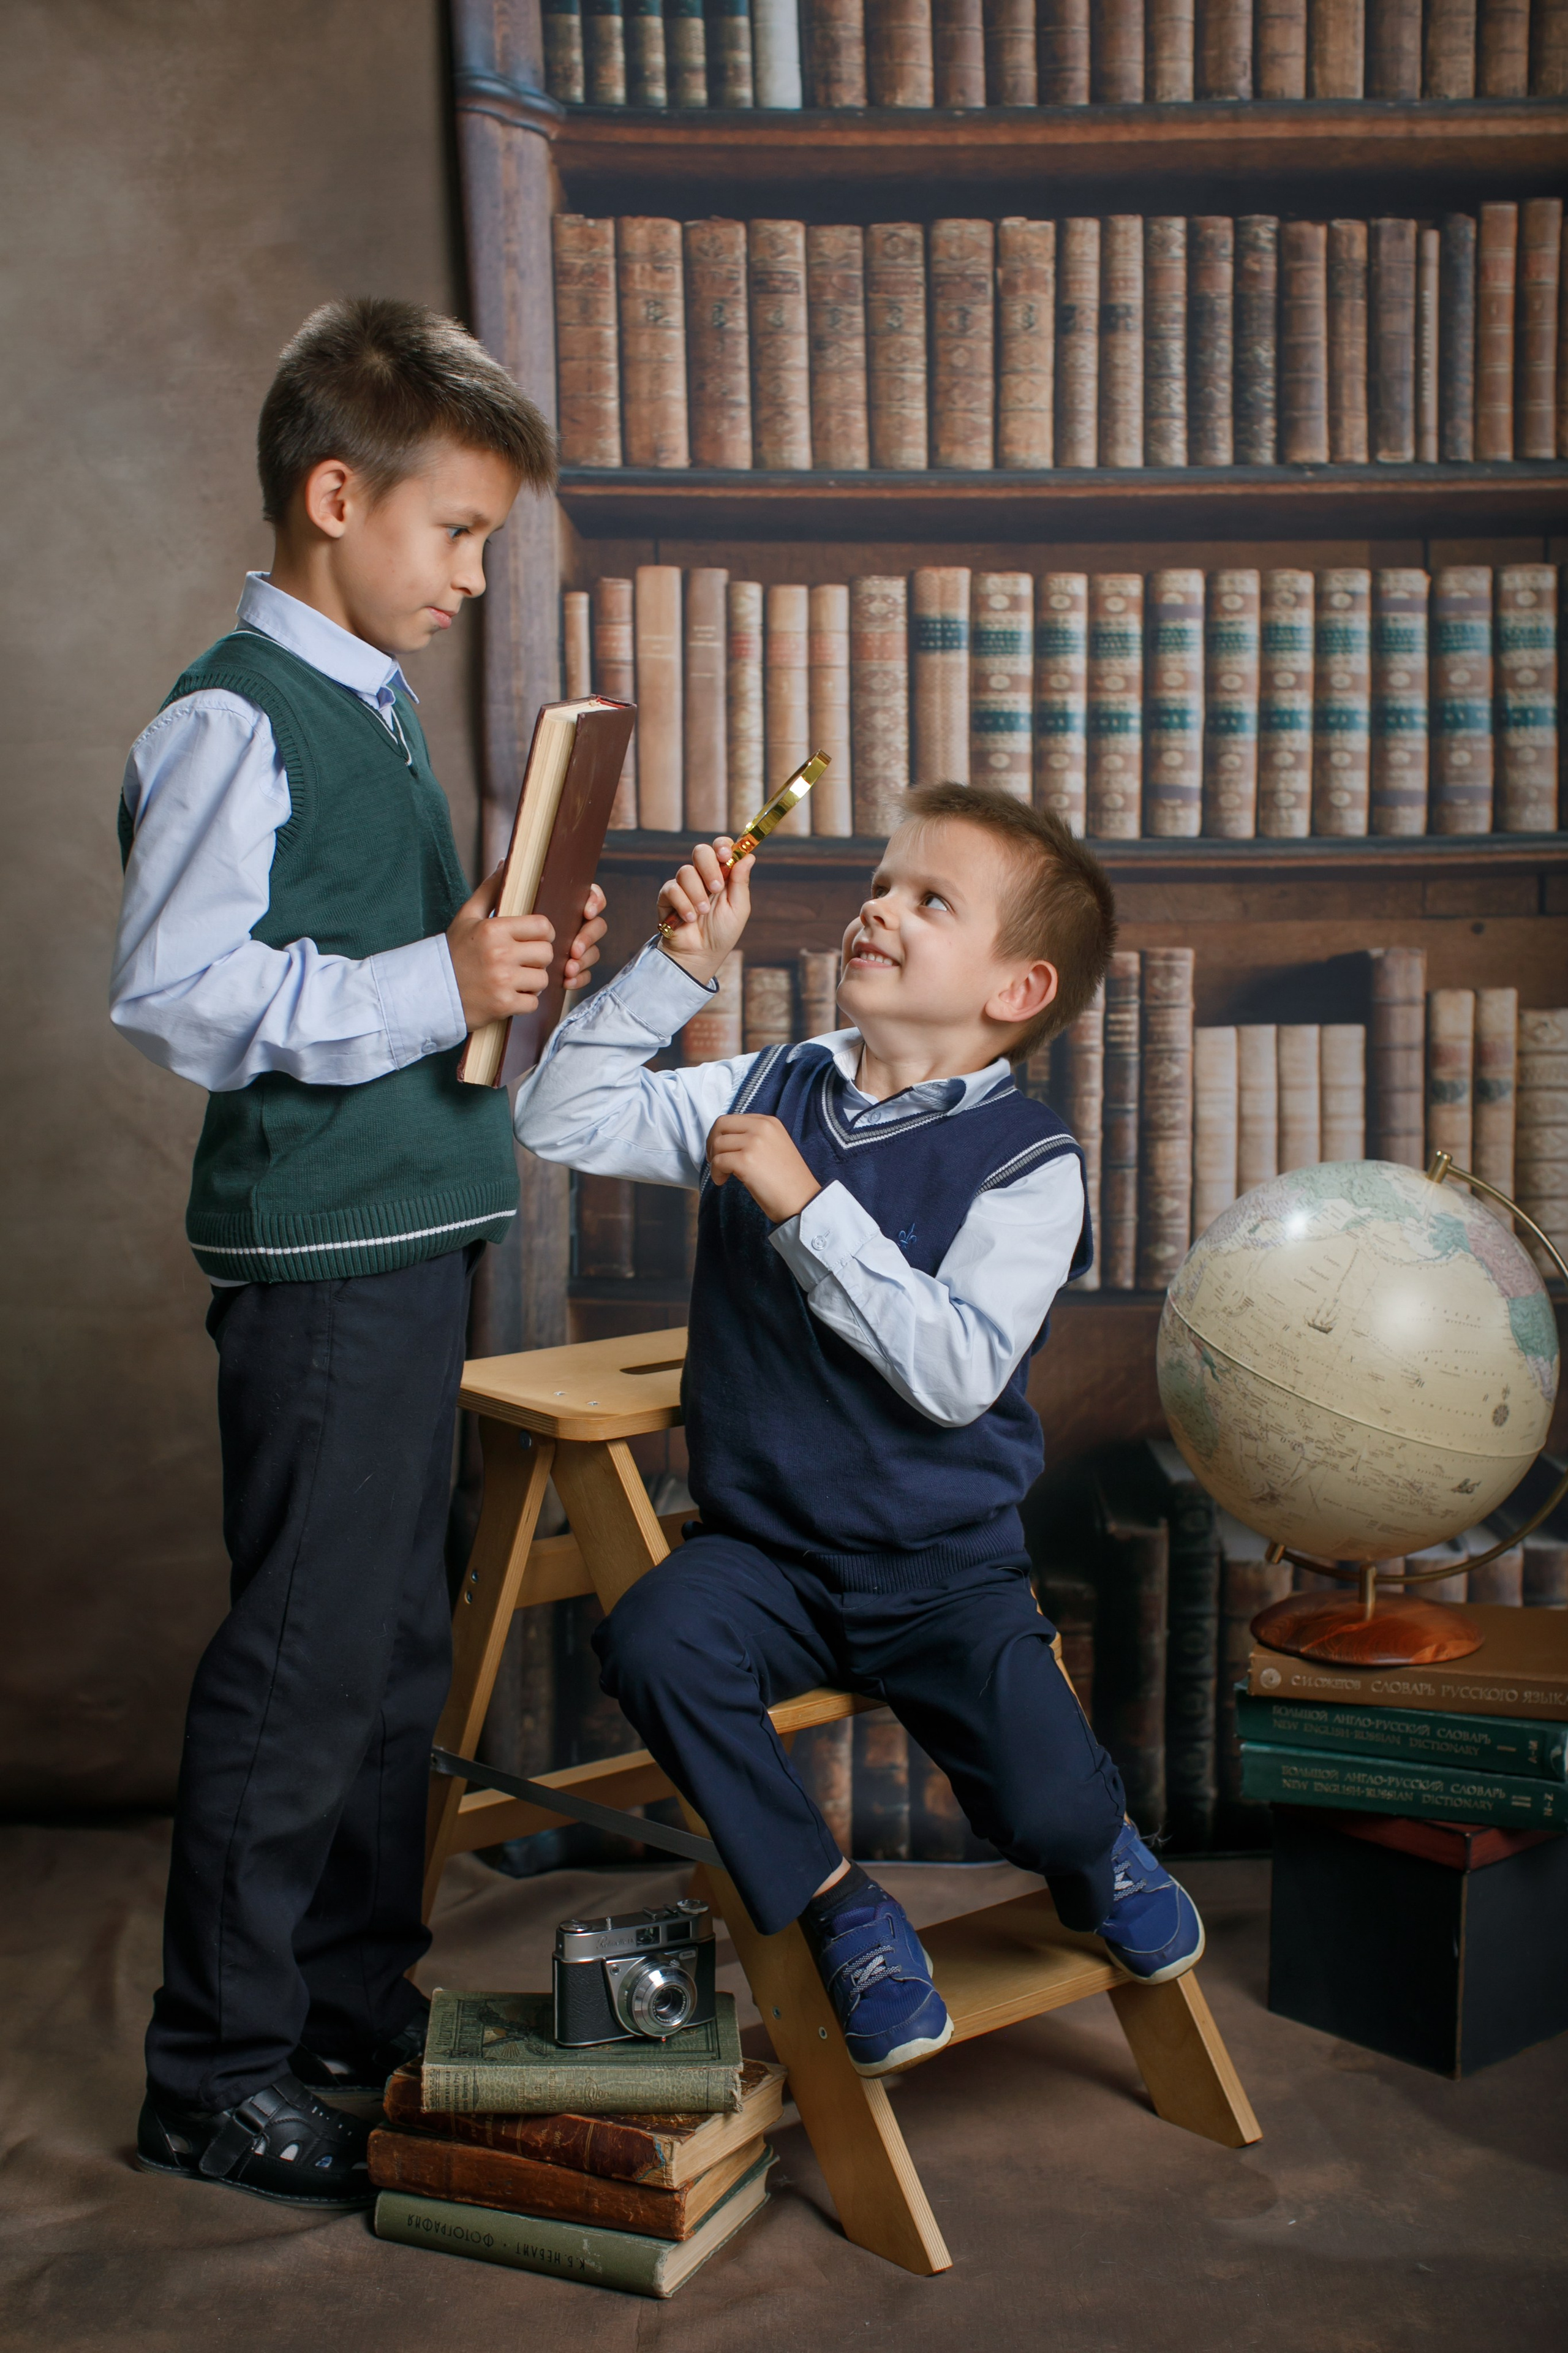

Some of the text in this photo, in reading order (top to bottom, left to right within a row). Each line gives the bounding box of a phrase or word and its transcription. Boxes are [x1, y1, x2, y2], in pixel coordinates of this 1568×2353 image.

[1371, 1679, 1436, 1696] СЛОВАРЬ
[1441, 1684, 1518, 1702] РУССКОГО
[1272, 1705, 1492, 1745] БОЛЬШОЙ АНГЛО-РУССКИЙ СЛОВАРЬ
[1273, 1718, 1480, 1756] NEW ENGLISH-RUSSIAN DICTIONARY
[1281, 1764, 1506, 1799] БОЛЬШОЙ АНГЛО-РУССКИЙ СЛОВАРЬ
[1282, 1778, 1494, 1811] NEW ENGLISH-RUSSIAN DICTIONARY
[407, 2213, 494, 2248] ФОТОГРАФИЯ
